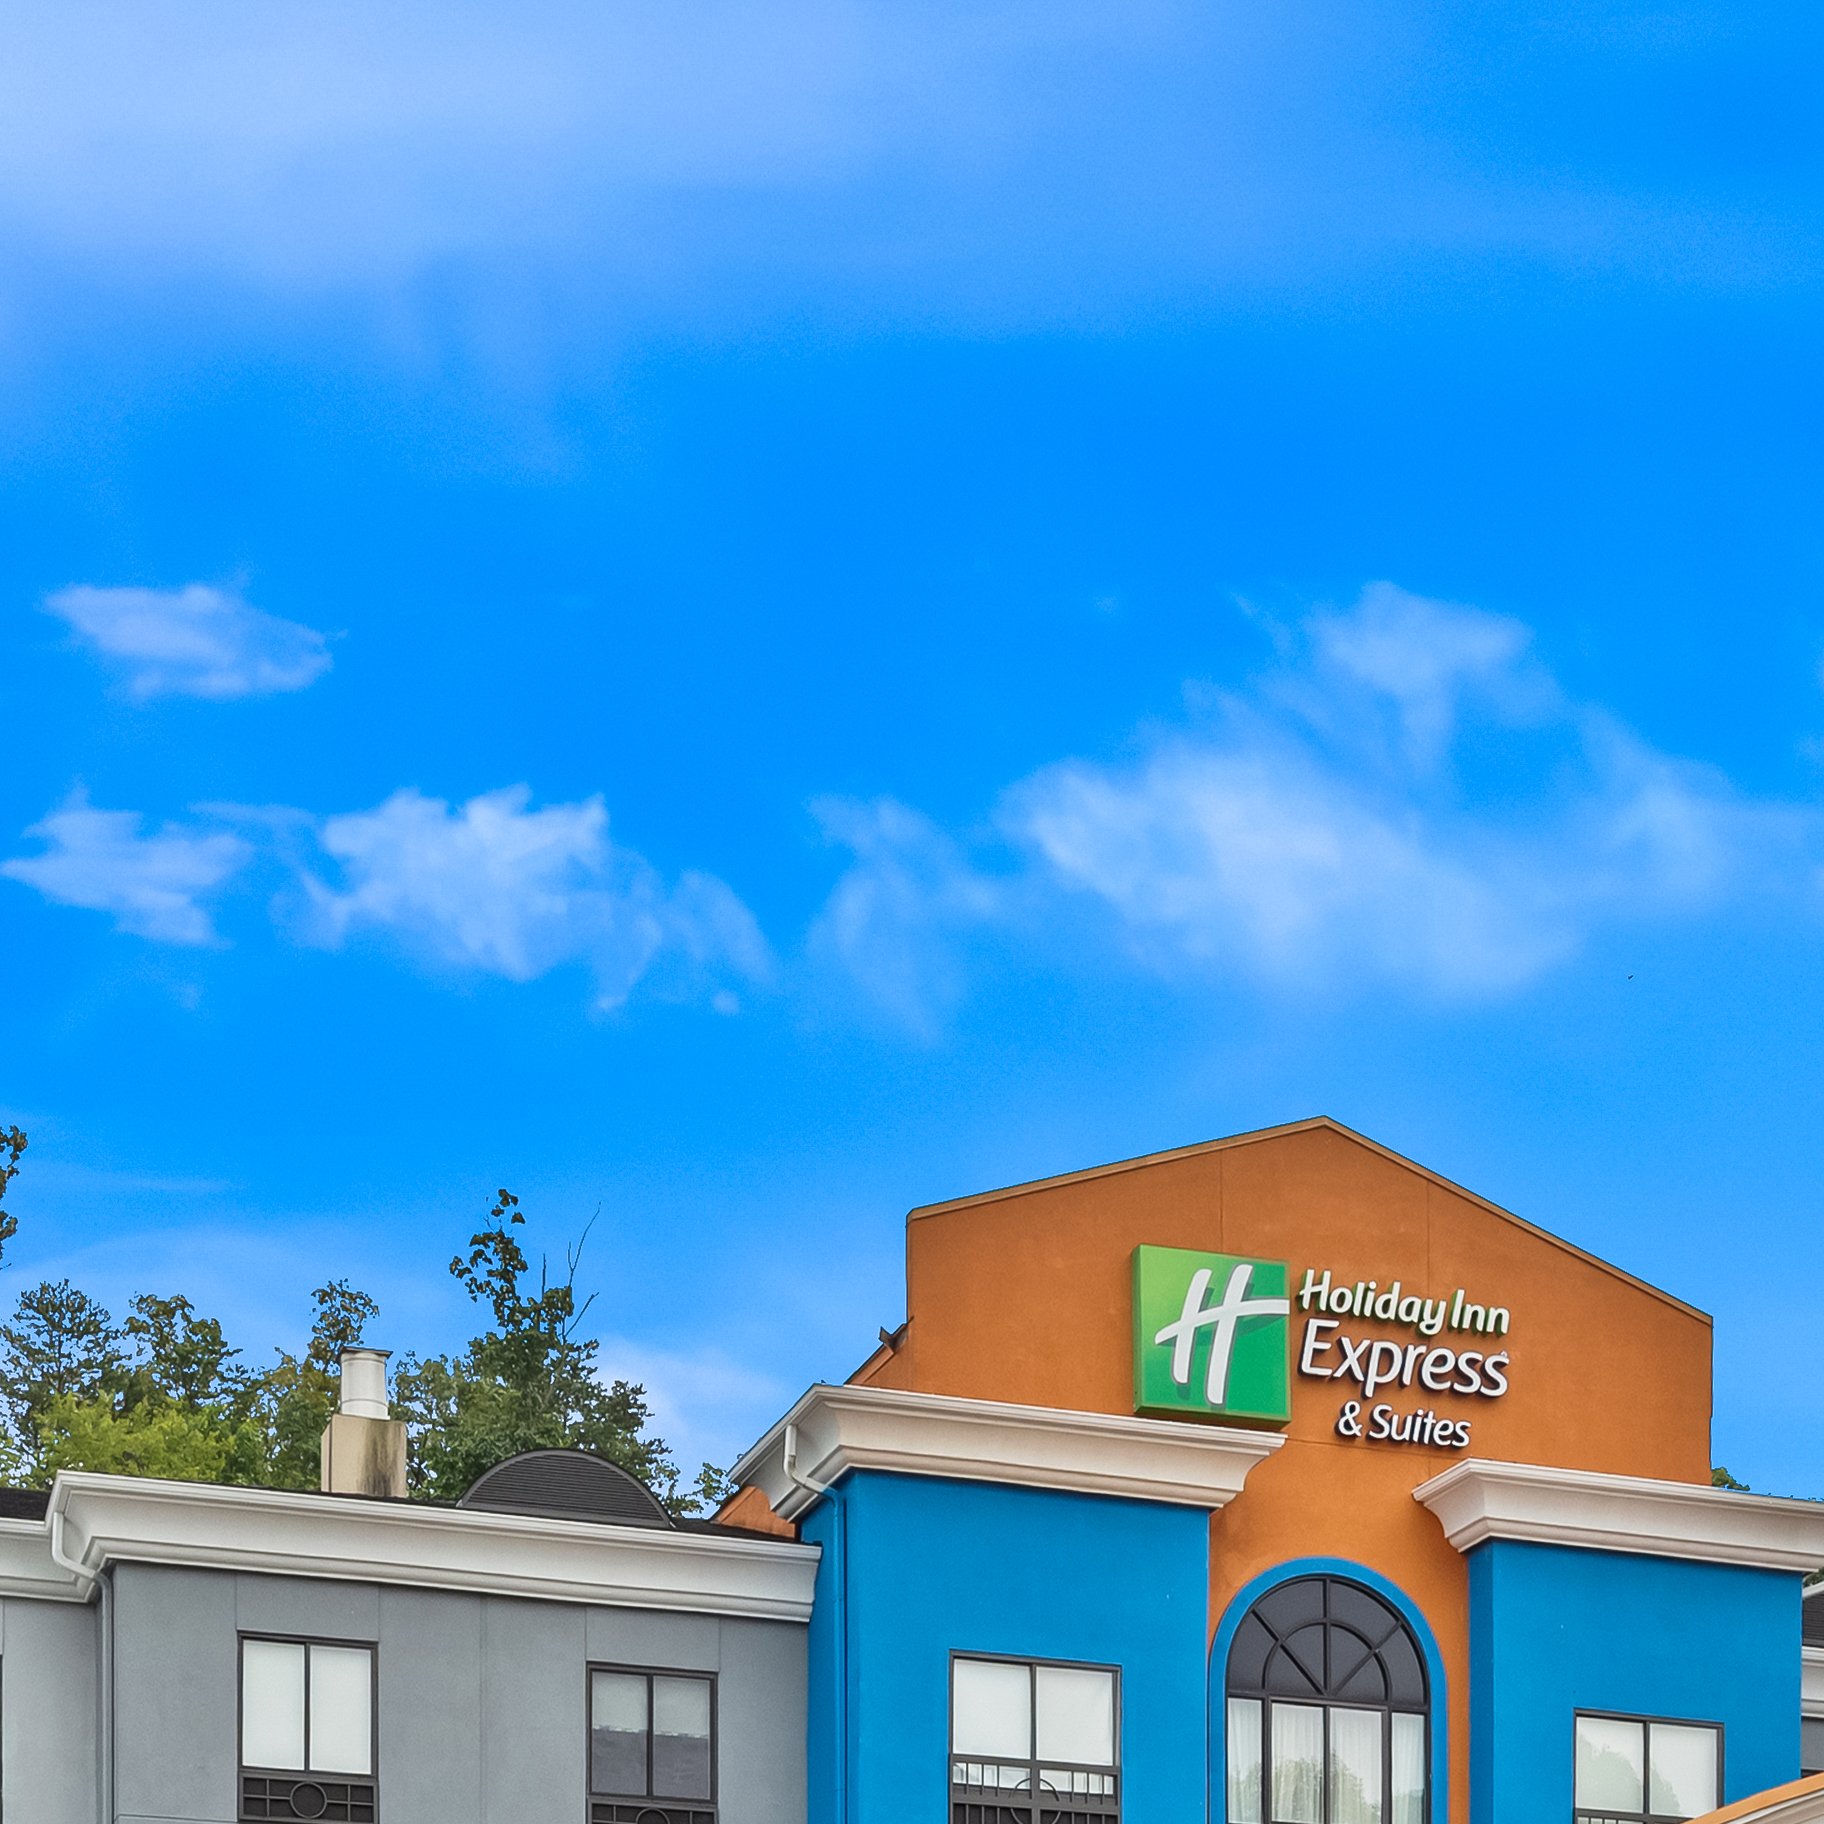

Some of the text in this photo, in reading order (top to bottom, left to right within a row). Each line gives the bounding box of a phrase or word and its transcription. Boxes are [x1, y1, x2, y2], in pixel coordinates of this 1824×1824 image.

[1299, 1268, 1511, 1336] Holiday Inn
[1299, 1317, 1511, 1399] Express
[1337, 1400, 1473, 1448] & Suites
